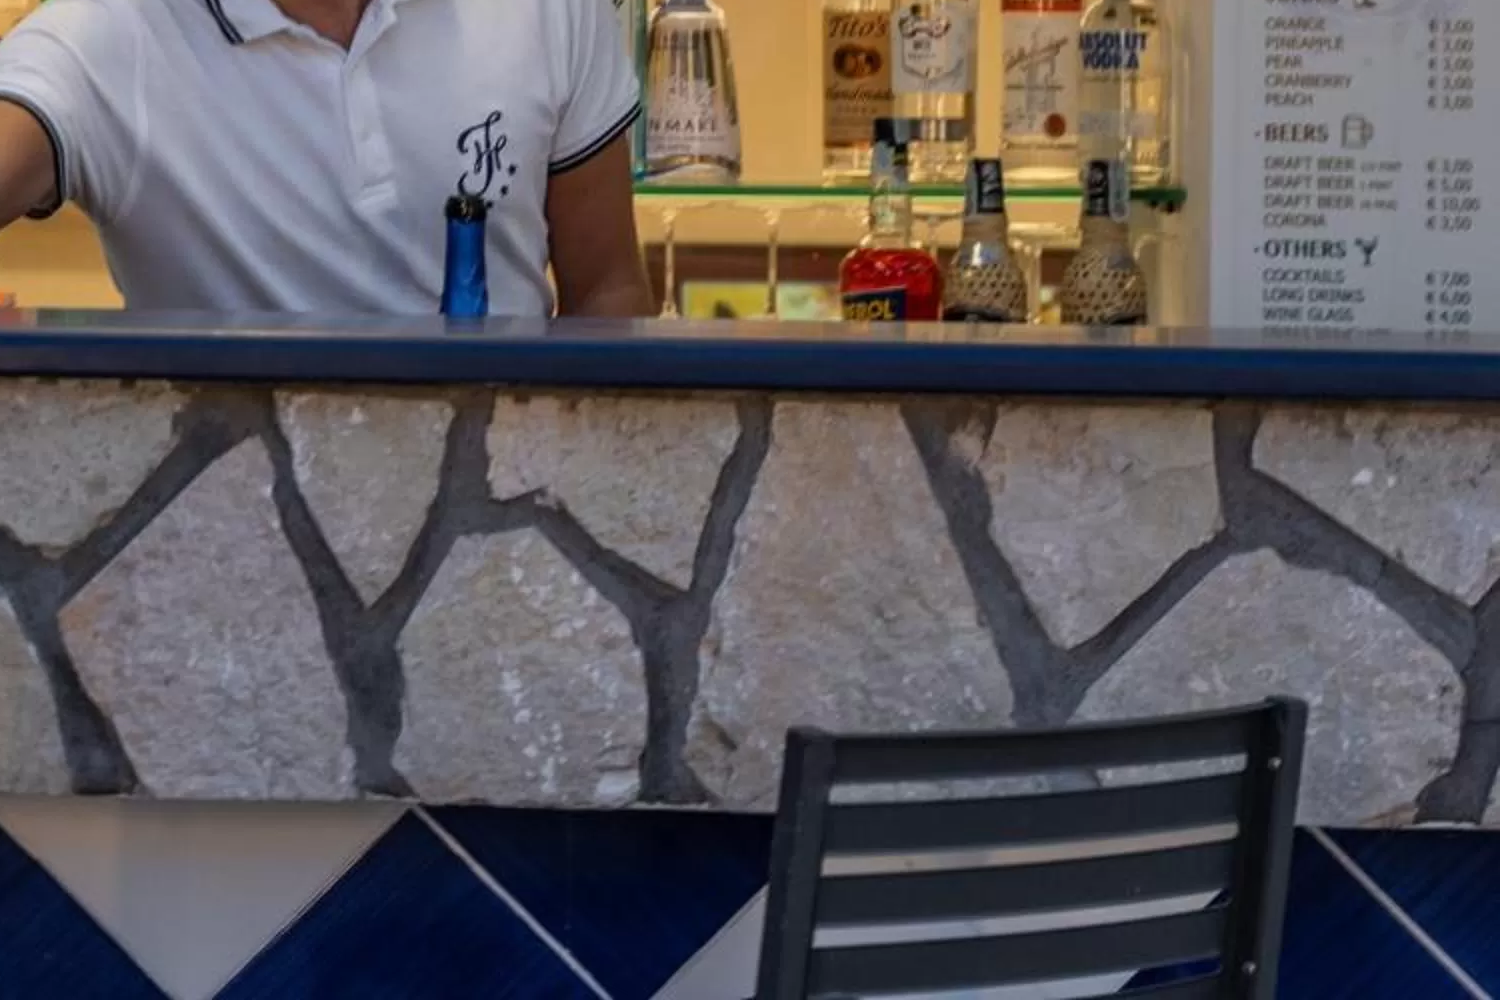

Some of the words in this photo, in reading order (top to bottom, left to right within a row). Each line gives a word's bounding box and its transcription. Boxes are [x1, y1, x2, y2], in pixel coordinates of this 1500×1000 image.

[827, 15, 888, 39] Tito's
[1079, 31, 1149, 52] ABSOLUT
[1264, 122, 1330, 143] BEERS
[1263, 238, 1348, 260] OTHERS
[1262, 267, 1346, 285] COCKTAILS
